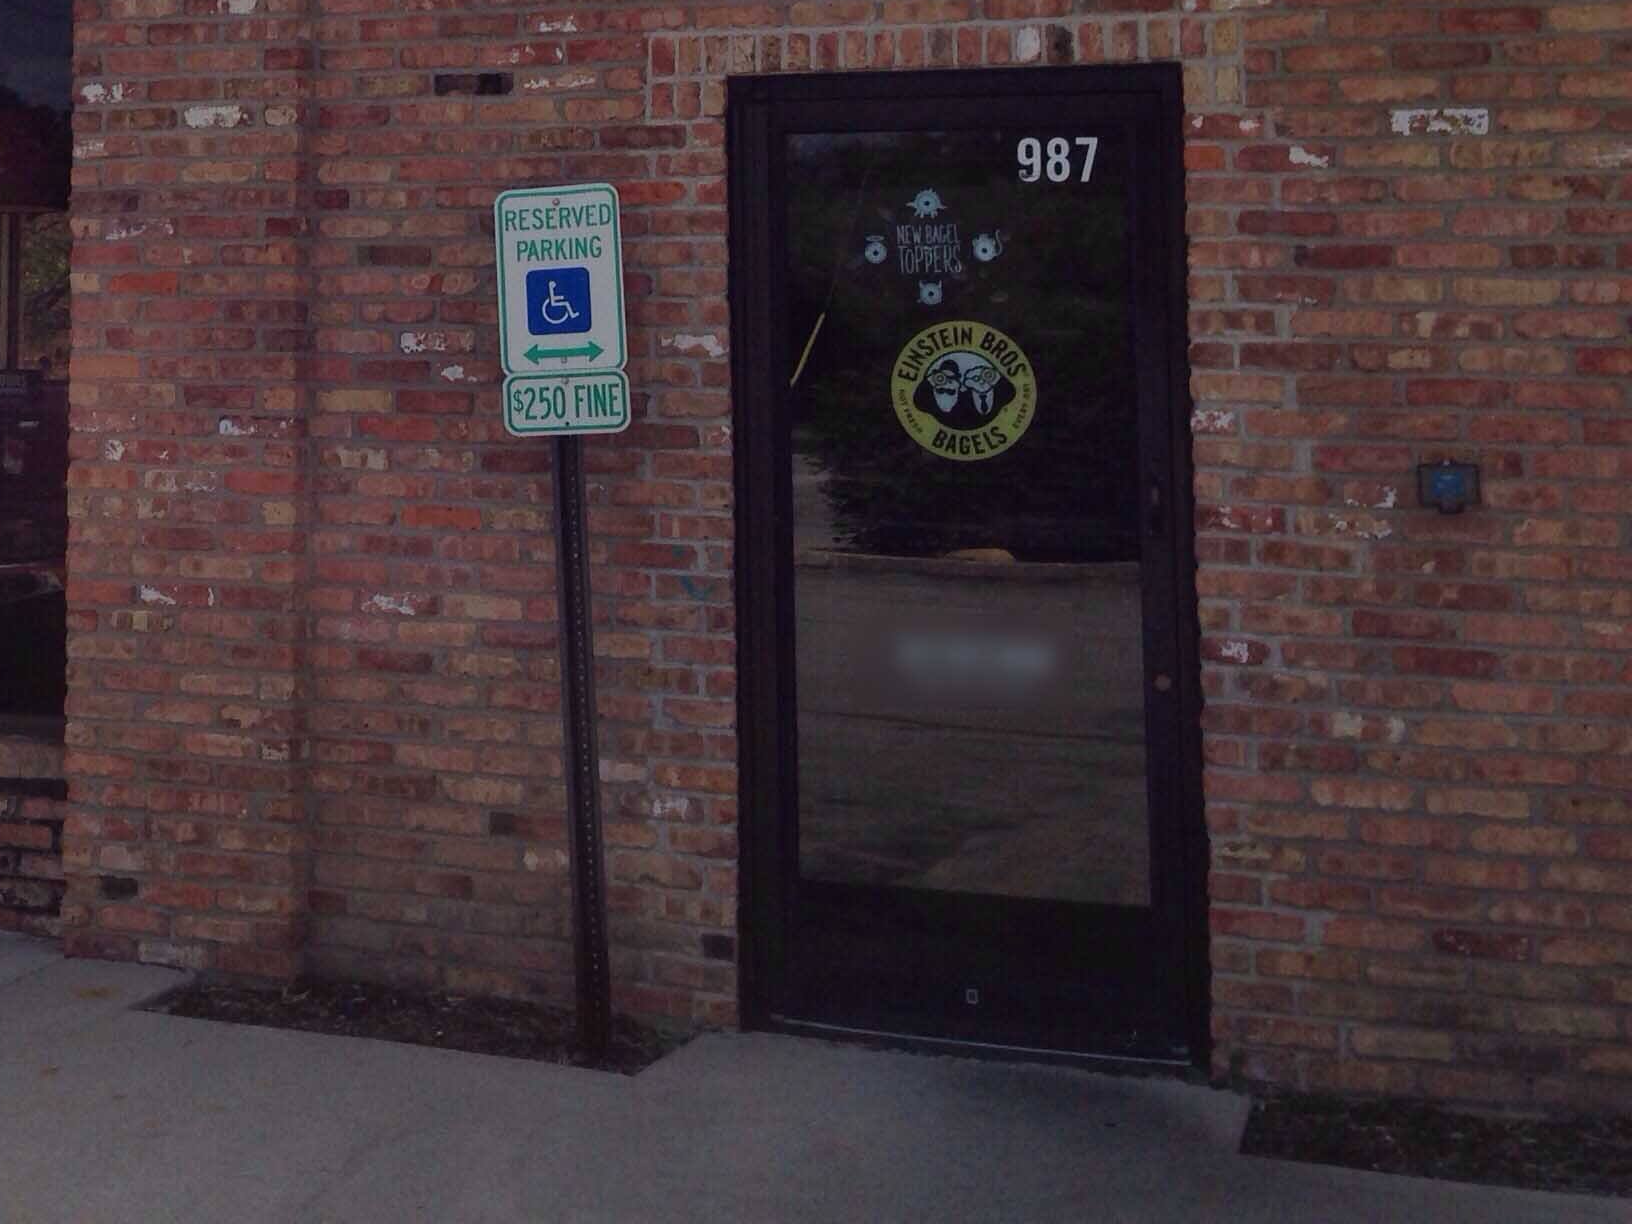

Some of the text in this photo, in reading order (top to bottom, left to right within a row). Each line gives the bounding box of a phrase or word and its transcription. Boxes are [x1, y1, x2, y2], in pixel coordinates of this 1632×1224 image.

[1016, 136, 1099, 183] 987
[504, 203, 612, 232] RESERVED
[896, 223, 961, 244] NEW BAGEL
[516, 236, 603, 262] PARKING
[897, 244, 963, 273] TOPPERS
[897, 326, 1027, 382] EINSTEIN BROS
[513, 383, 622, 420] $250 FINE
[931, 425, 1008, 456] BAGELS
